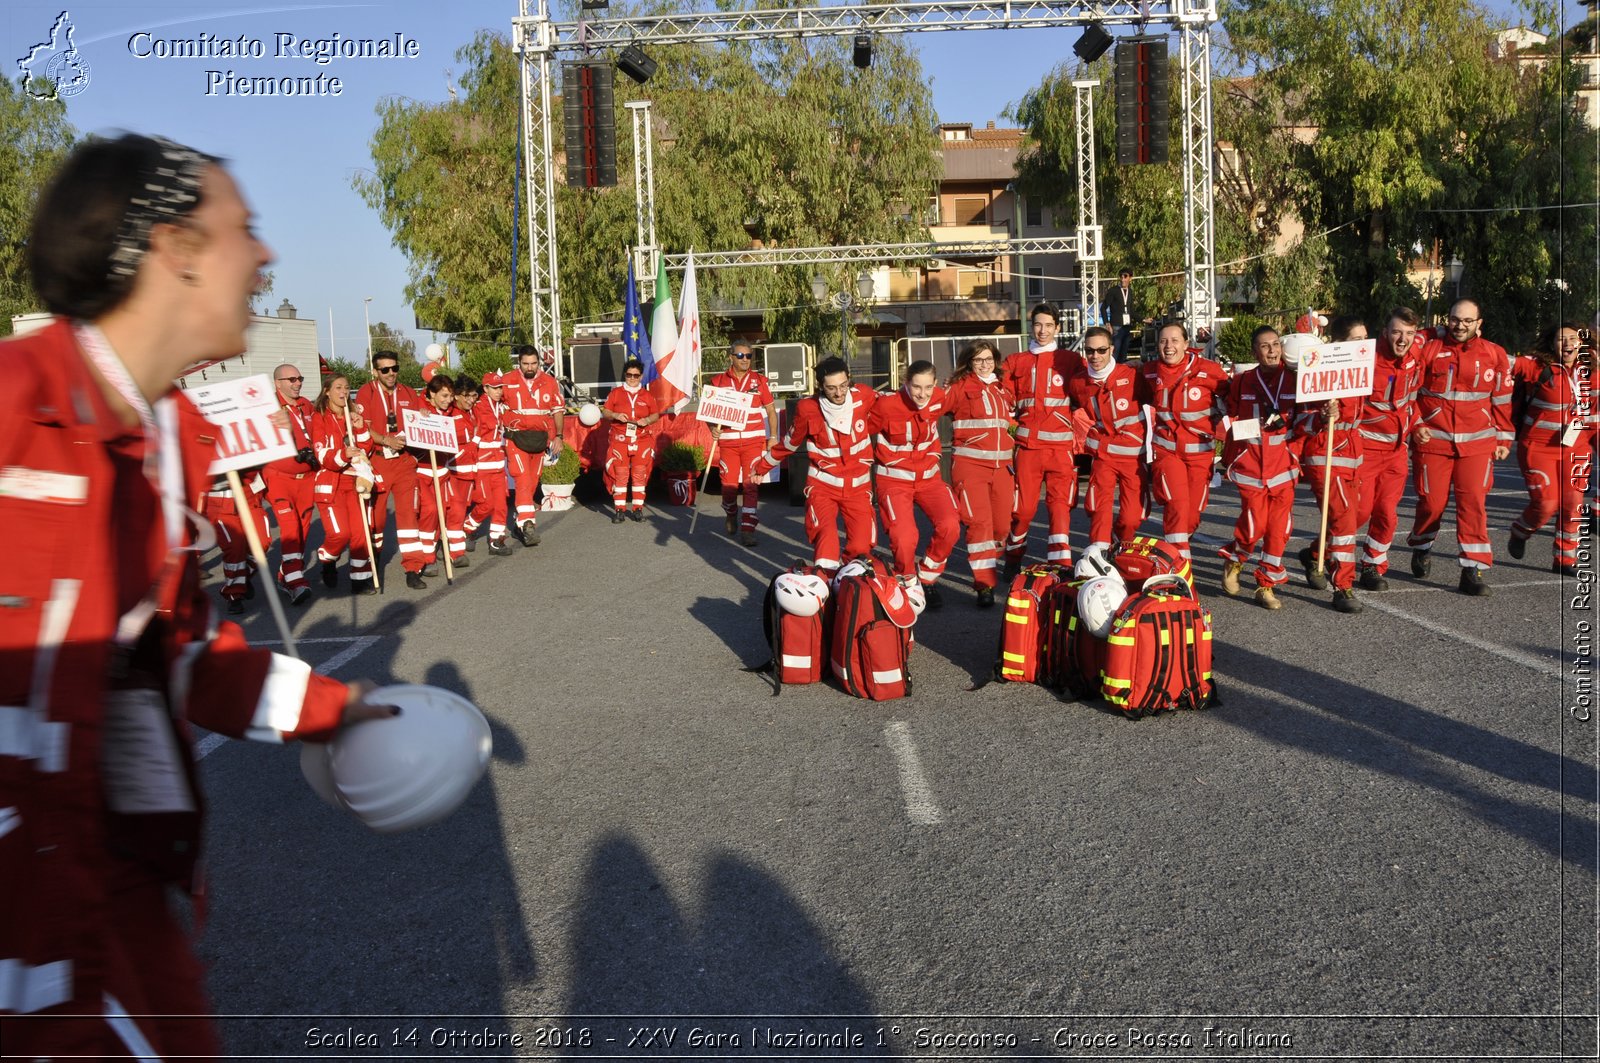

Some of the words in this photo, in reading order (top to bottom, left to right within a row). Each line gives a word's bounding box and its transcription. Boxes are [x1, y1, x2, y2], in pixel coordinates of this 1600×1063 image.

[1301, 366, 1369, 394] CAMPANIA
[701, 402, 746, 424] LOMBARDIA
[408, 426, 456, 448] UMBRIA
